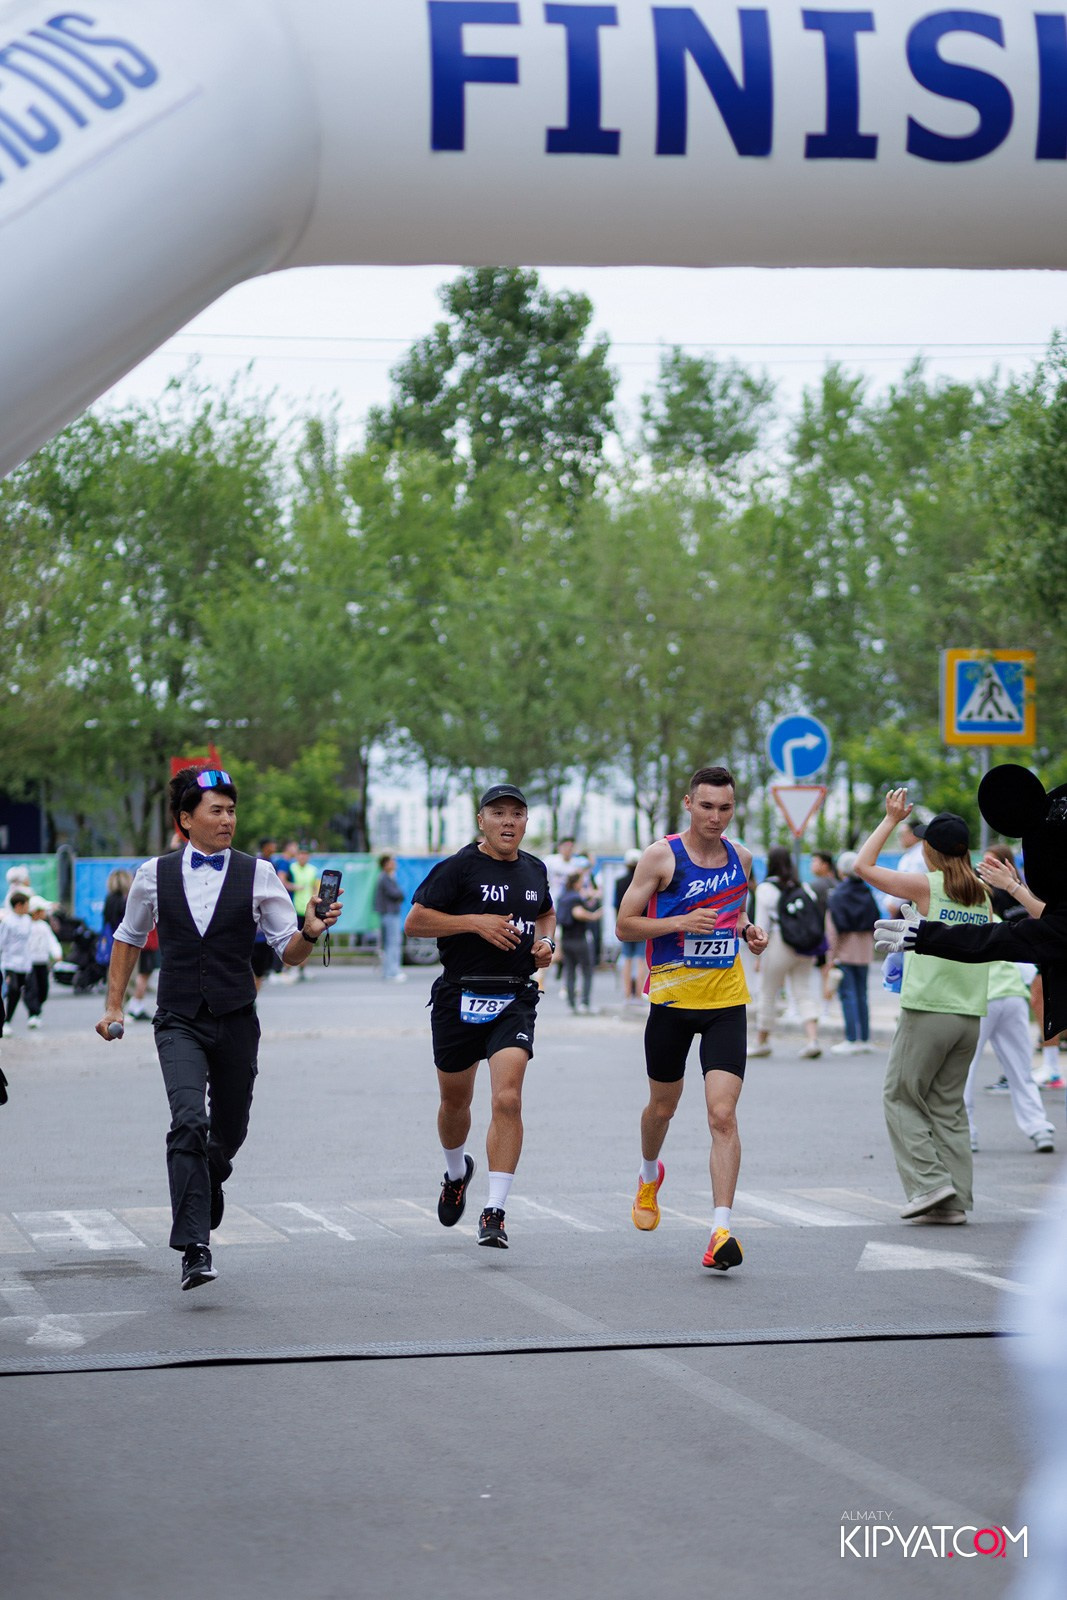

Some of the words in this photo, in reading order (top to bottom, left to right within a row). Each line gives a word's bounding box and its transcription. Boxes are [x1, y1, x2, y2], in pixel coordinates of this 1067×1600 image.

[426, 0, 1067, 163] FINIS
[939, 908, 989, 925] ВОЛОНТЕР
[694, 940, 729, 956] 1731
